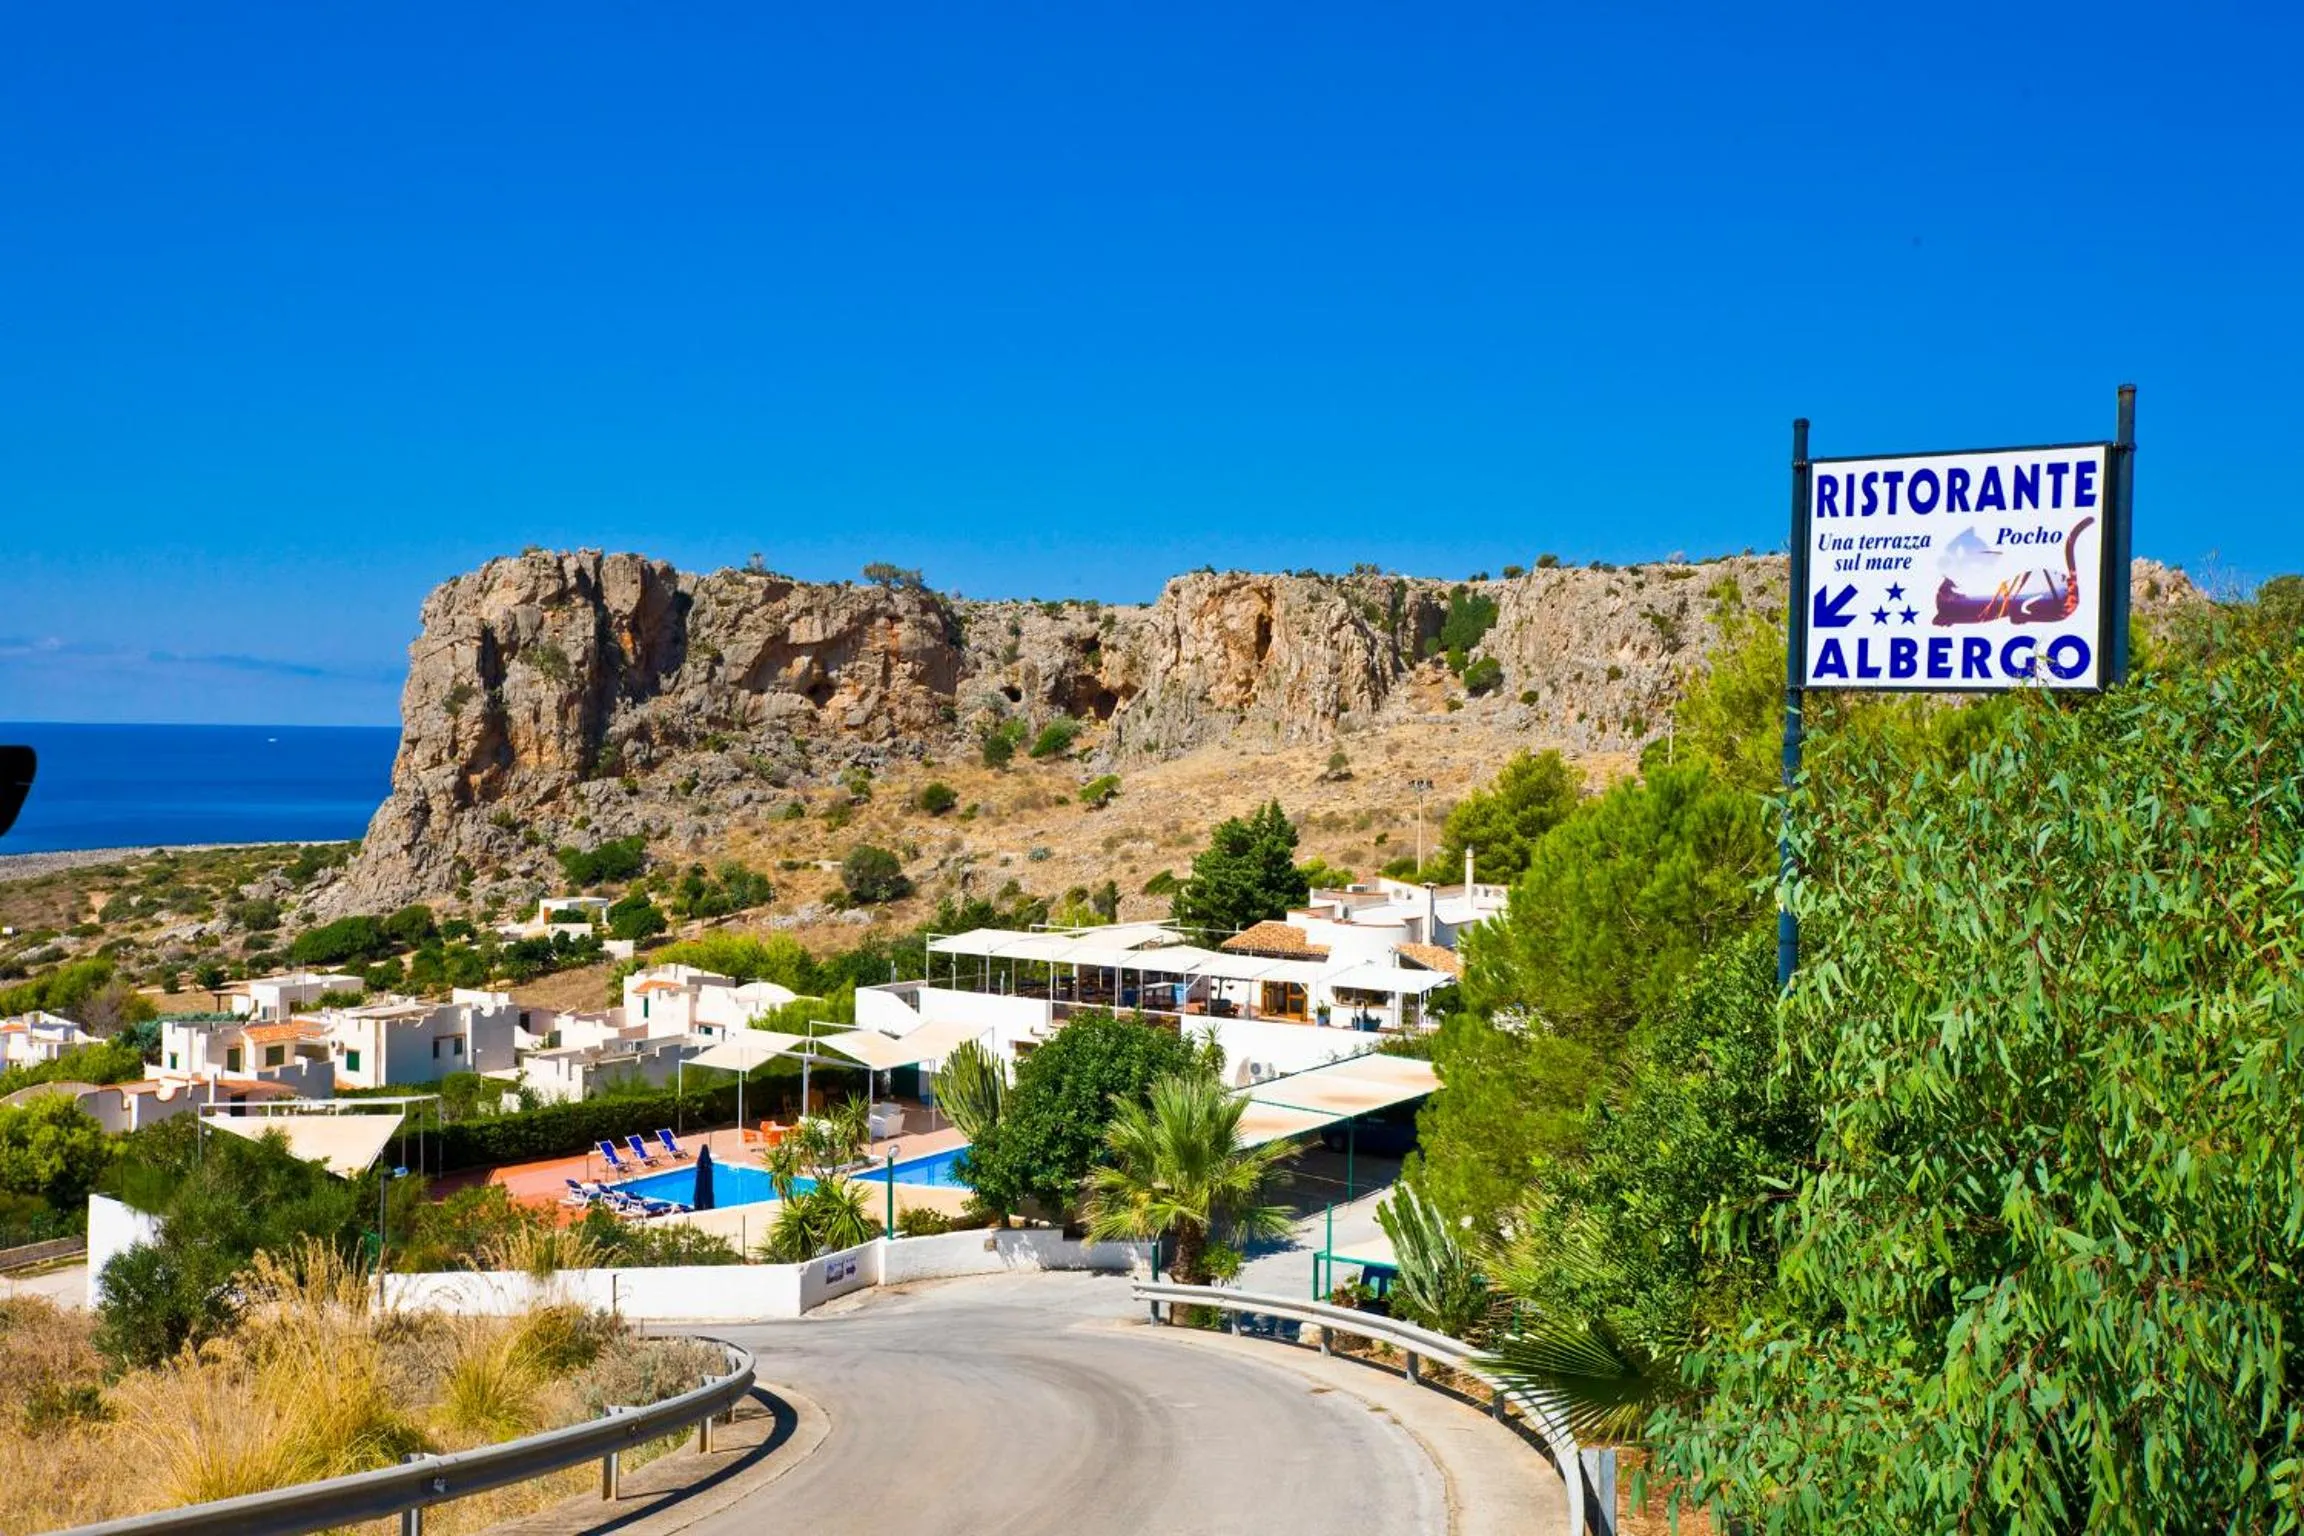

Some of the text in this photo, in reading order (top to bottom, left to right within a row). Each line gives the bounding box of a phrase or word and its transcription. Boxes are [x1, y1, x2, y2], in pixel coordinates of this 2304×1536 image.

[1816, 460, 2097, 518] RISTORANTE
[1818, 533, 1931, 550] Una terrazza
[1996, 526, 2062, 546] Pocho
[1834, 554, 1912, 572] sul mare
[1812, 634, 2091, 680] ALBERGO
